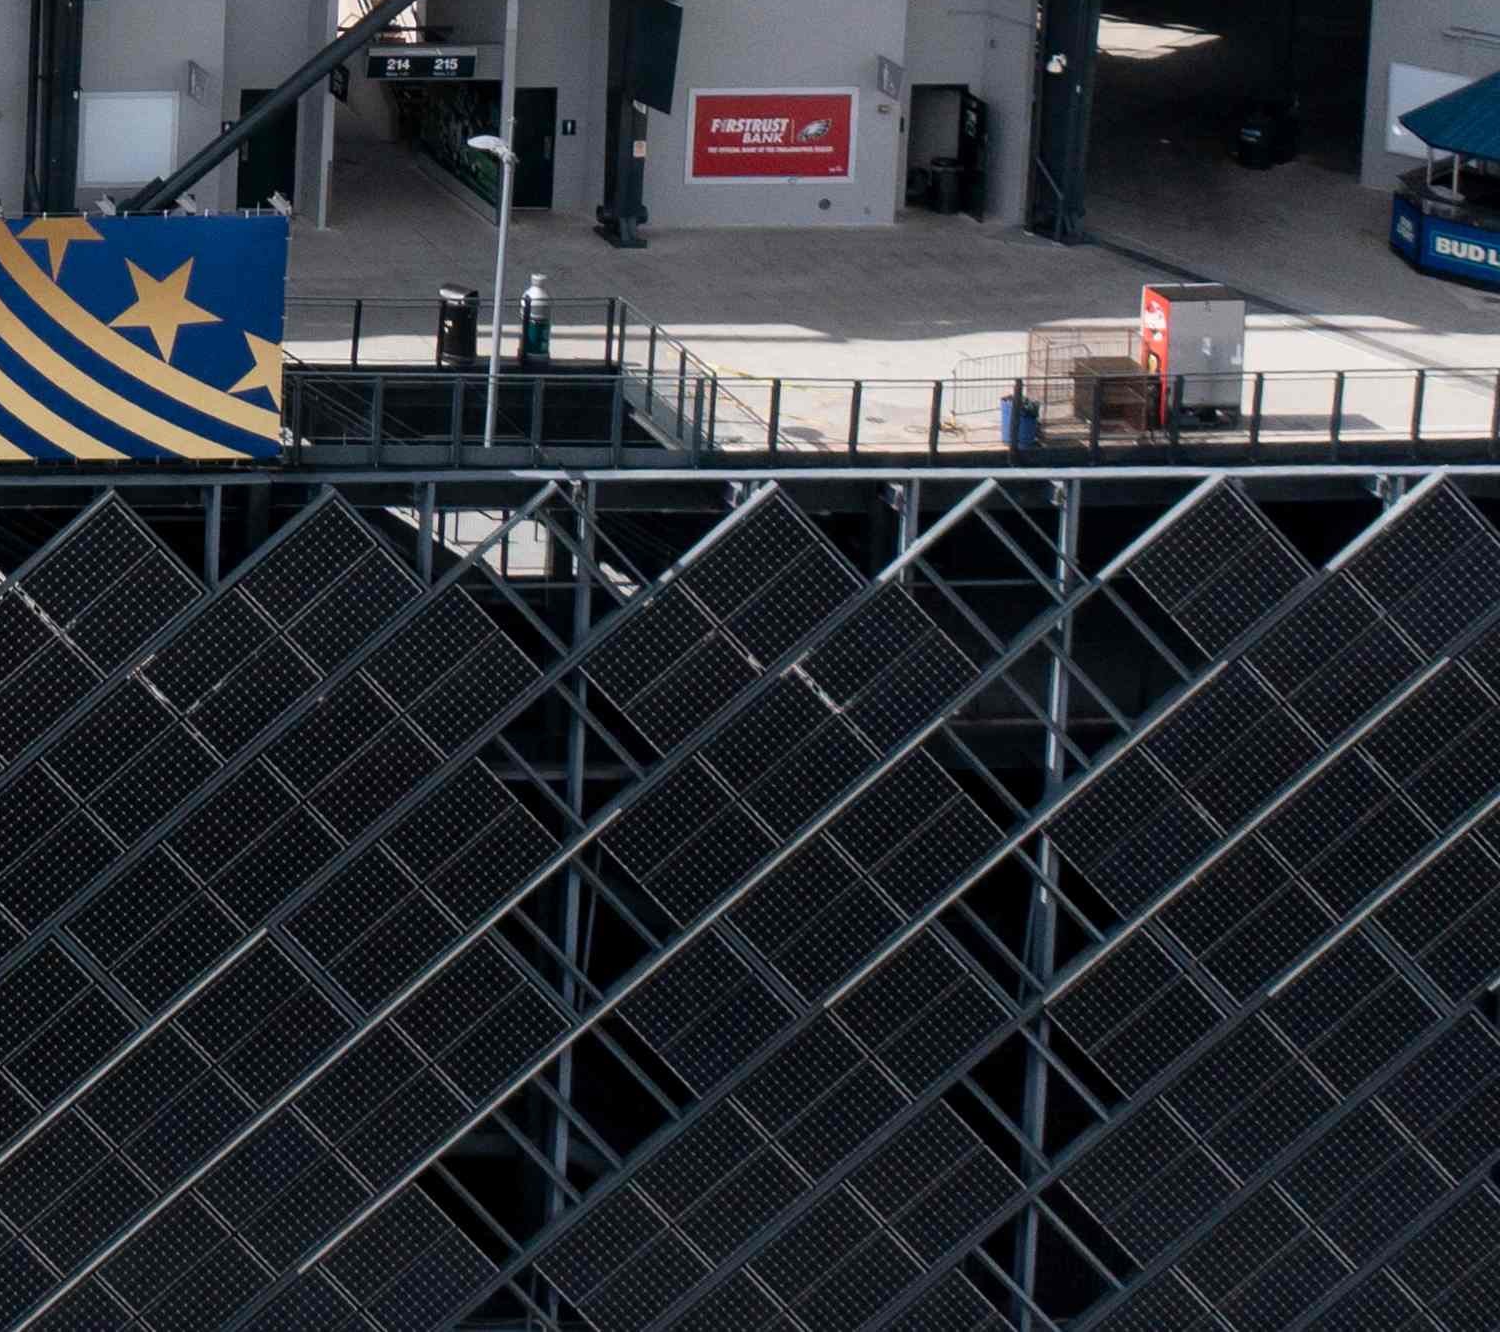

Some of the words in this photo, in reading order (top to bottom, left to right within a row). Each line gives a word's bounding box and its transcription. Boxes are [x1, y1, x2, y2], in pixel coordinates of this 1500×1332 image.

[386, 58, 411, 71] 214
[433, 58, 459, 71] 215
[742, 133, 783, 144] BANK
[1435, 236, 1486, 264] BUD
